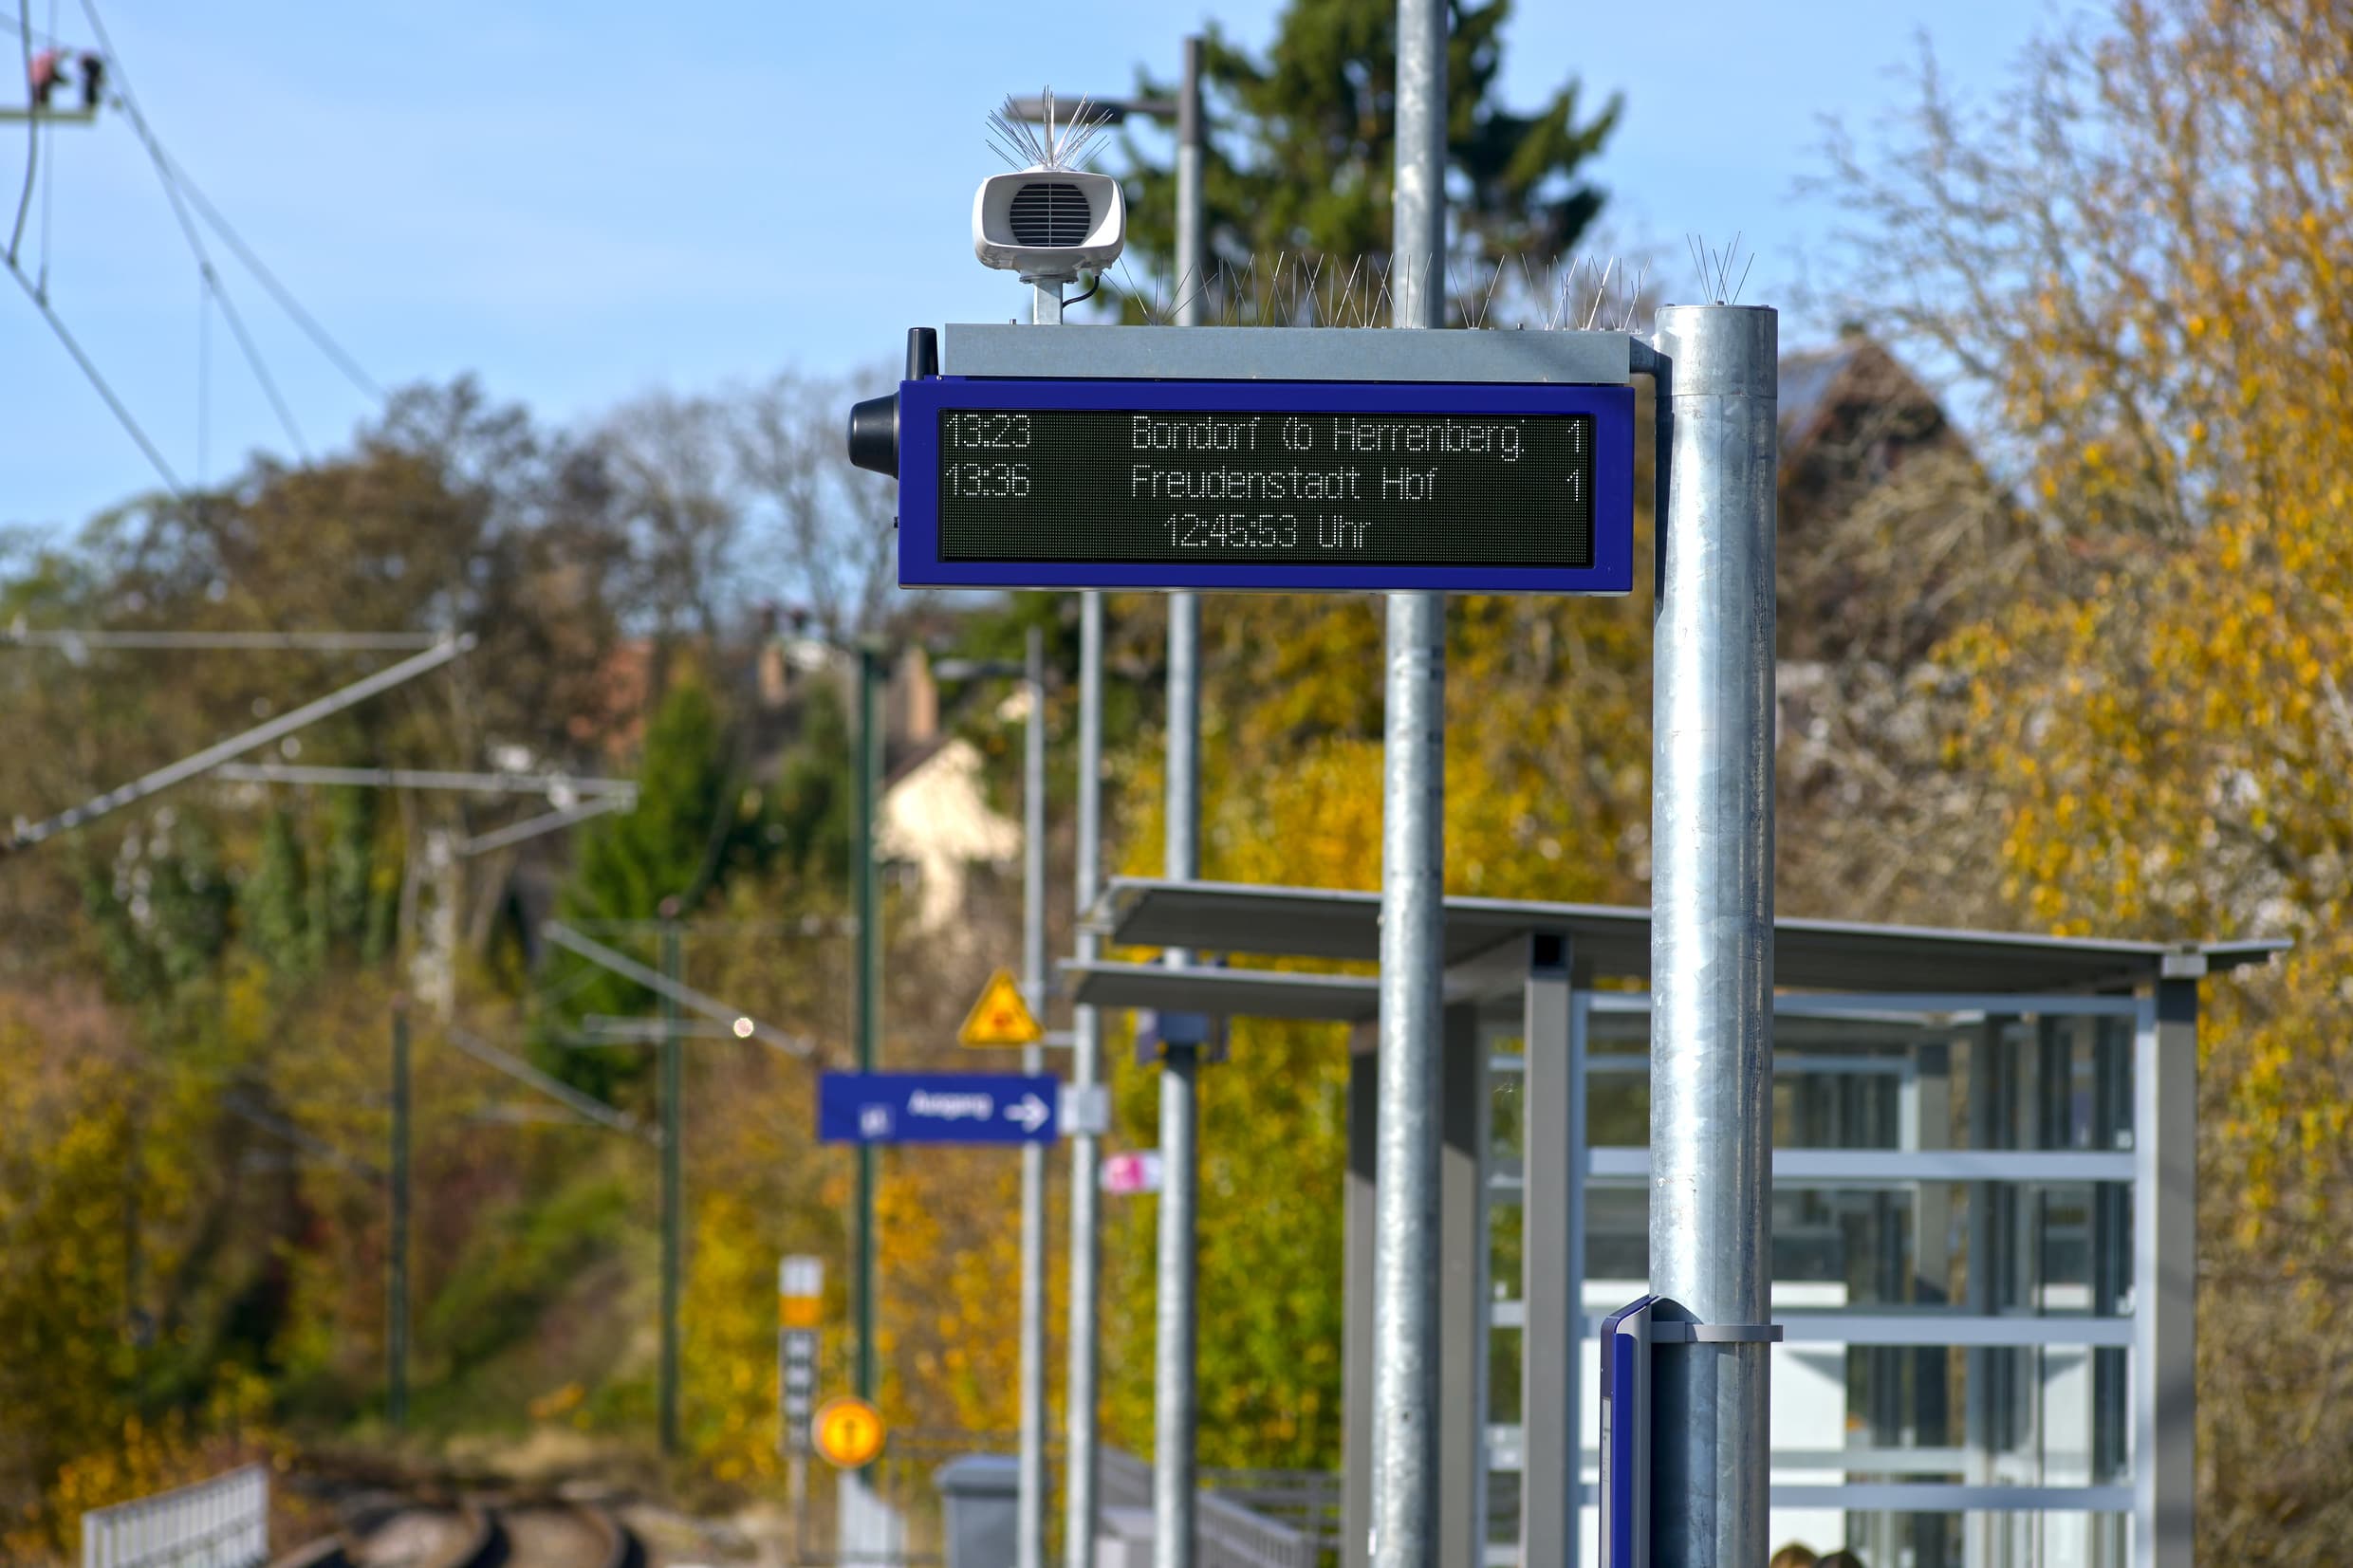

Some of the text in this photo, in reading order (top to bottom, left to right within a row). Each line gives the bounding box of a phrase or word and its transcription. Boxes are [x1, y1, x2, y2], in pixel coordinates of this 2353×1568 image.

[946, 414, 1031, 448] 13:23
[1132, 415, 1261, 451] Bondorf
[1282, 416, 1313, 451] (b
[1566, 418, 1581, 453] 1
[945, 462, 1031, 497] 13:36
[1132, 464, 1438, 501] Freudenstadt Hbf
[1566, 468, 1580, 502] 1
[1163, 512, 1372, 548] 12:45:53 Uhr
